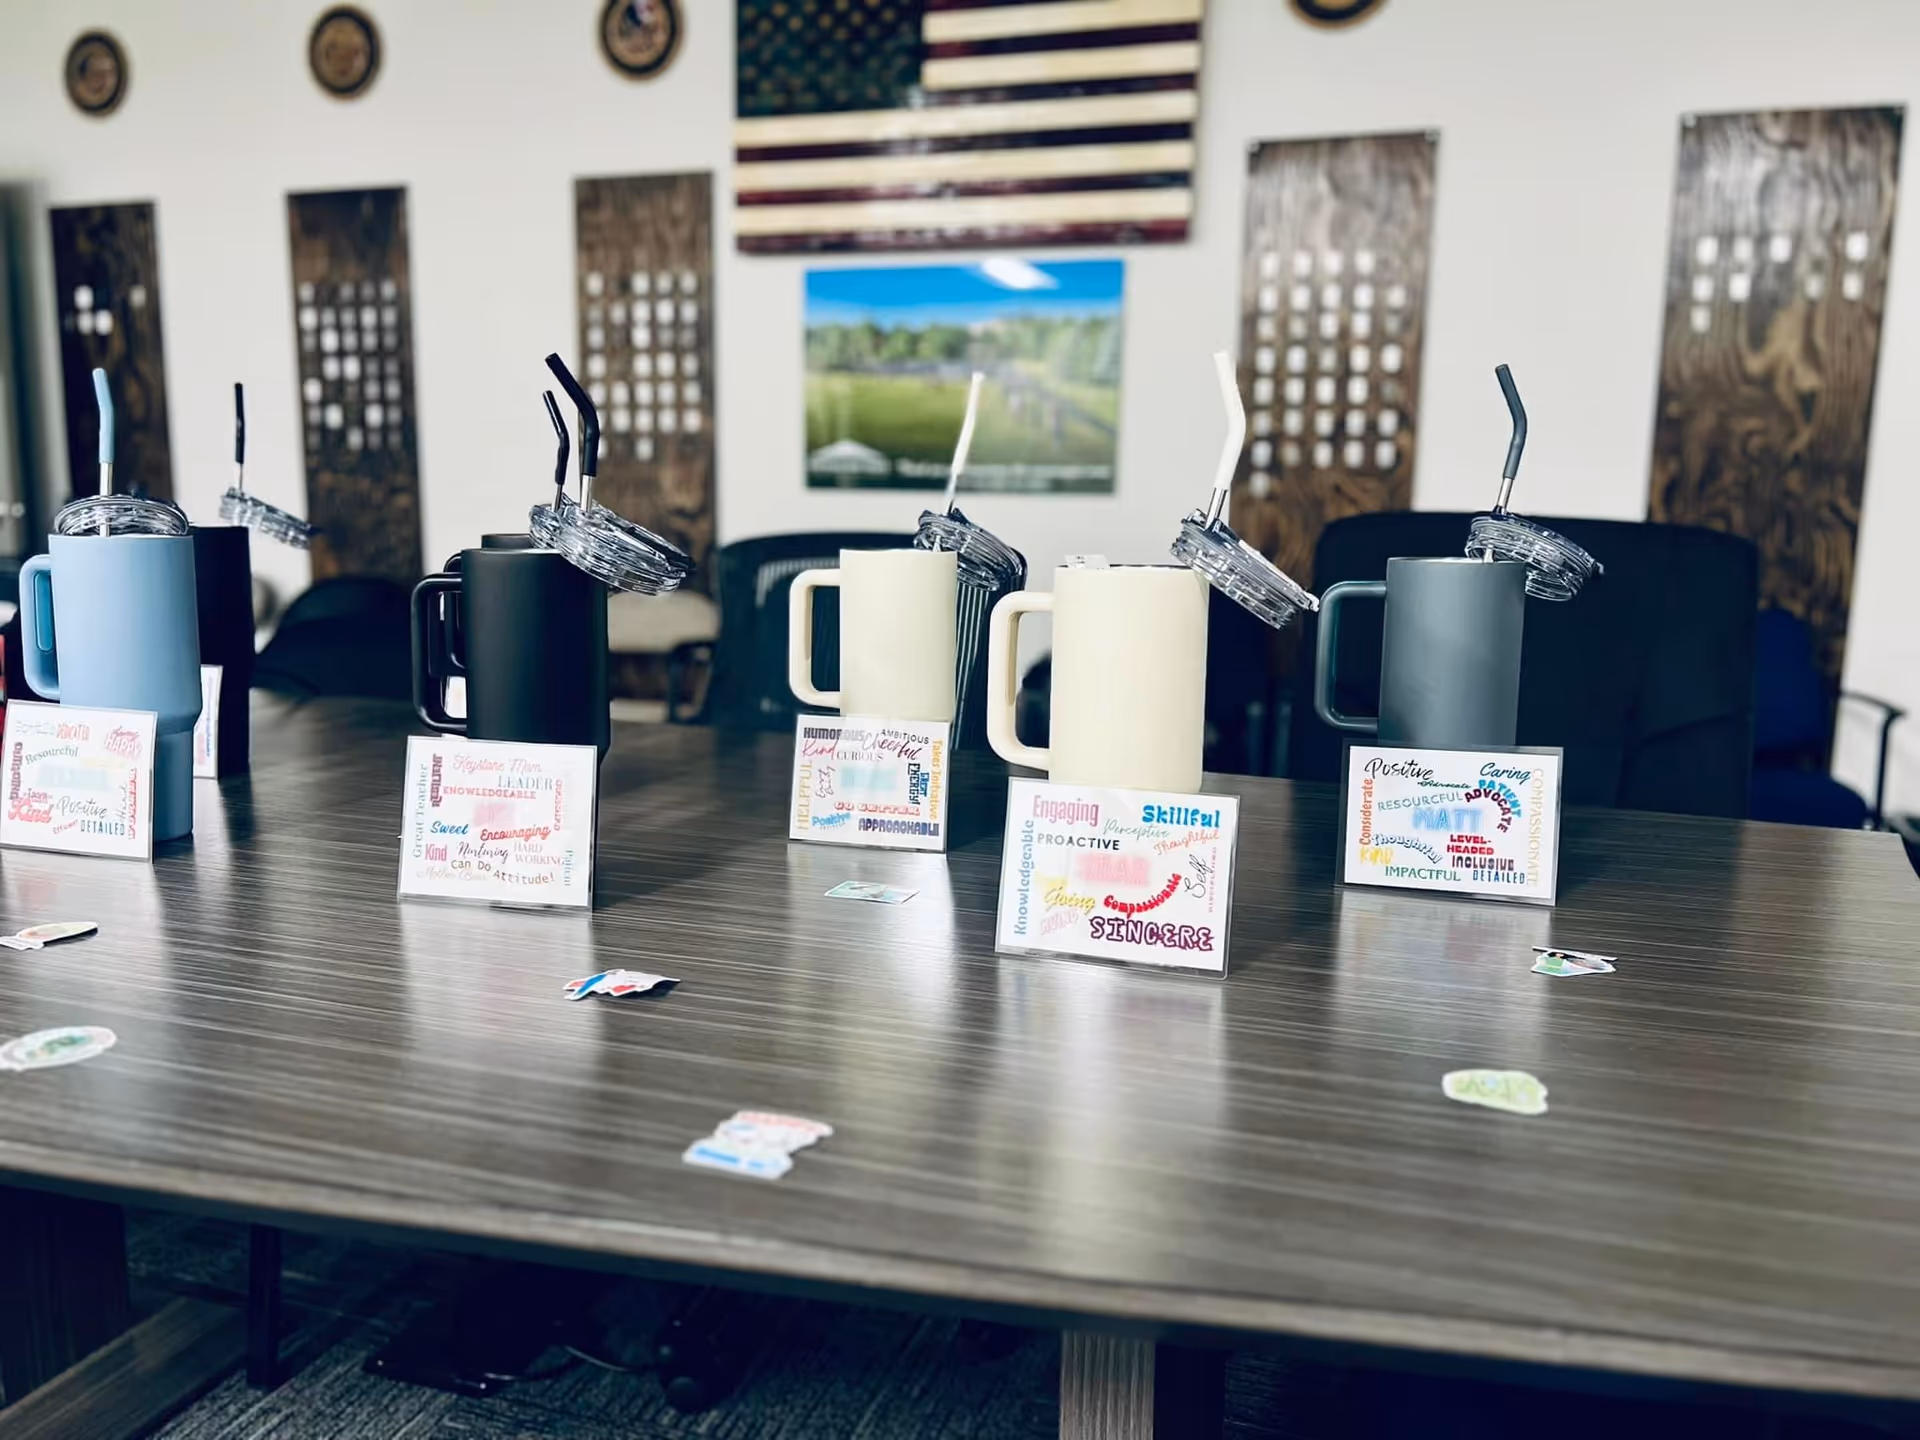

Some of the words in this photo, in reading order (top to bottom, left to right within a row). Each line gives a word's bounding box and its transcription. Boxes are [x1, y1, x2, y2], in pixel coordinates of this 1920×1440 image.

[803, 727, 865, 741] HUMOROUS
[881, 729, 929, 745] AMBITIOUS
[25, 746, 78, 765] Resourceful
[802, 739, 839, 760] Kind
[837, 751, 884, 761] CURIOUS
[864, 732, 922, 760] Cheerful
[932, 739, 943, 769] Takes
[1364, 757, 1434, 780] Positive
[1480, 762, 1531, 785] Caring
[416, 764, 428, 818] Teacher
[443, 786, 537, 799] KNOWLEDGEABLE
[498, 776, 553, 791] LEADER
[796, 760, 814, 830] HELPFUL
[56, 796, 108, 819] Positive
[929, 771, 941, 821] Initiative
[1478, 779, 1522, 818] PATIENT
[8, 797, 54, 823] Kind
[1033, 795, 1099, 827] Engaging
[1142, 805, 1220, 829] Skillful
[1359, 778, 1374, 846] Considerate
[1464, 787, 1512, 833] ADVOCATE
[80, 820, 125, 836] DETAILED
[430, 821, 469, 835] Sweet
[480, 824, 551, 842] Encouraging
[1103, 818, 1169, 840] Perceptive
[1527, 768, 1544, 885] COMPASSIONATE
[413, 822, 424, 858] Great
[514, 842, 544, 853] HARD
[1037, 833, 1120, 851] PROACTIVE
[1154, 830, 1219, 855] Thoughtful
[1372, 833, 1443, 864] Thoughtful
[1446, 845, 1494, 855] HEADED
[1450, 834, 1492, 844] LEVEL-
[425, 843, 447, 862] Kind
[458, 842, 508, 864] Nurturing
[451, 860, 471, 870] Can
[478, 861, 491, 872] Do
[493, 872, 555, 885] Attitude!
[1014, 820, 1034, 935] Knowledgeable
[1184, 854, 1213, 899] Self
[1385, 866, 1461, 882] IMPACTFUL
[1473, 869, 1526, 884] DETAILED
[1103, 872, 1182, 918] Compassionate
[1089, 916, 1215, 951] SINCERE
